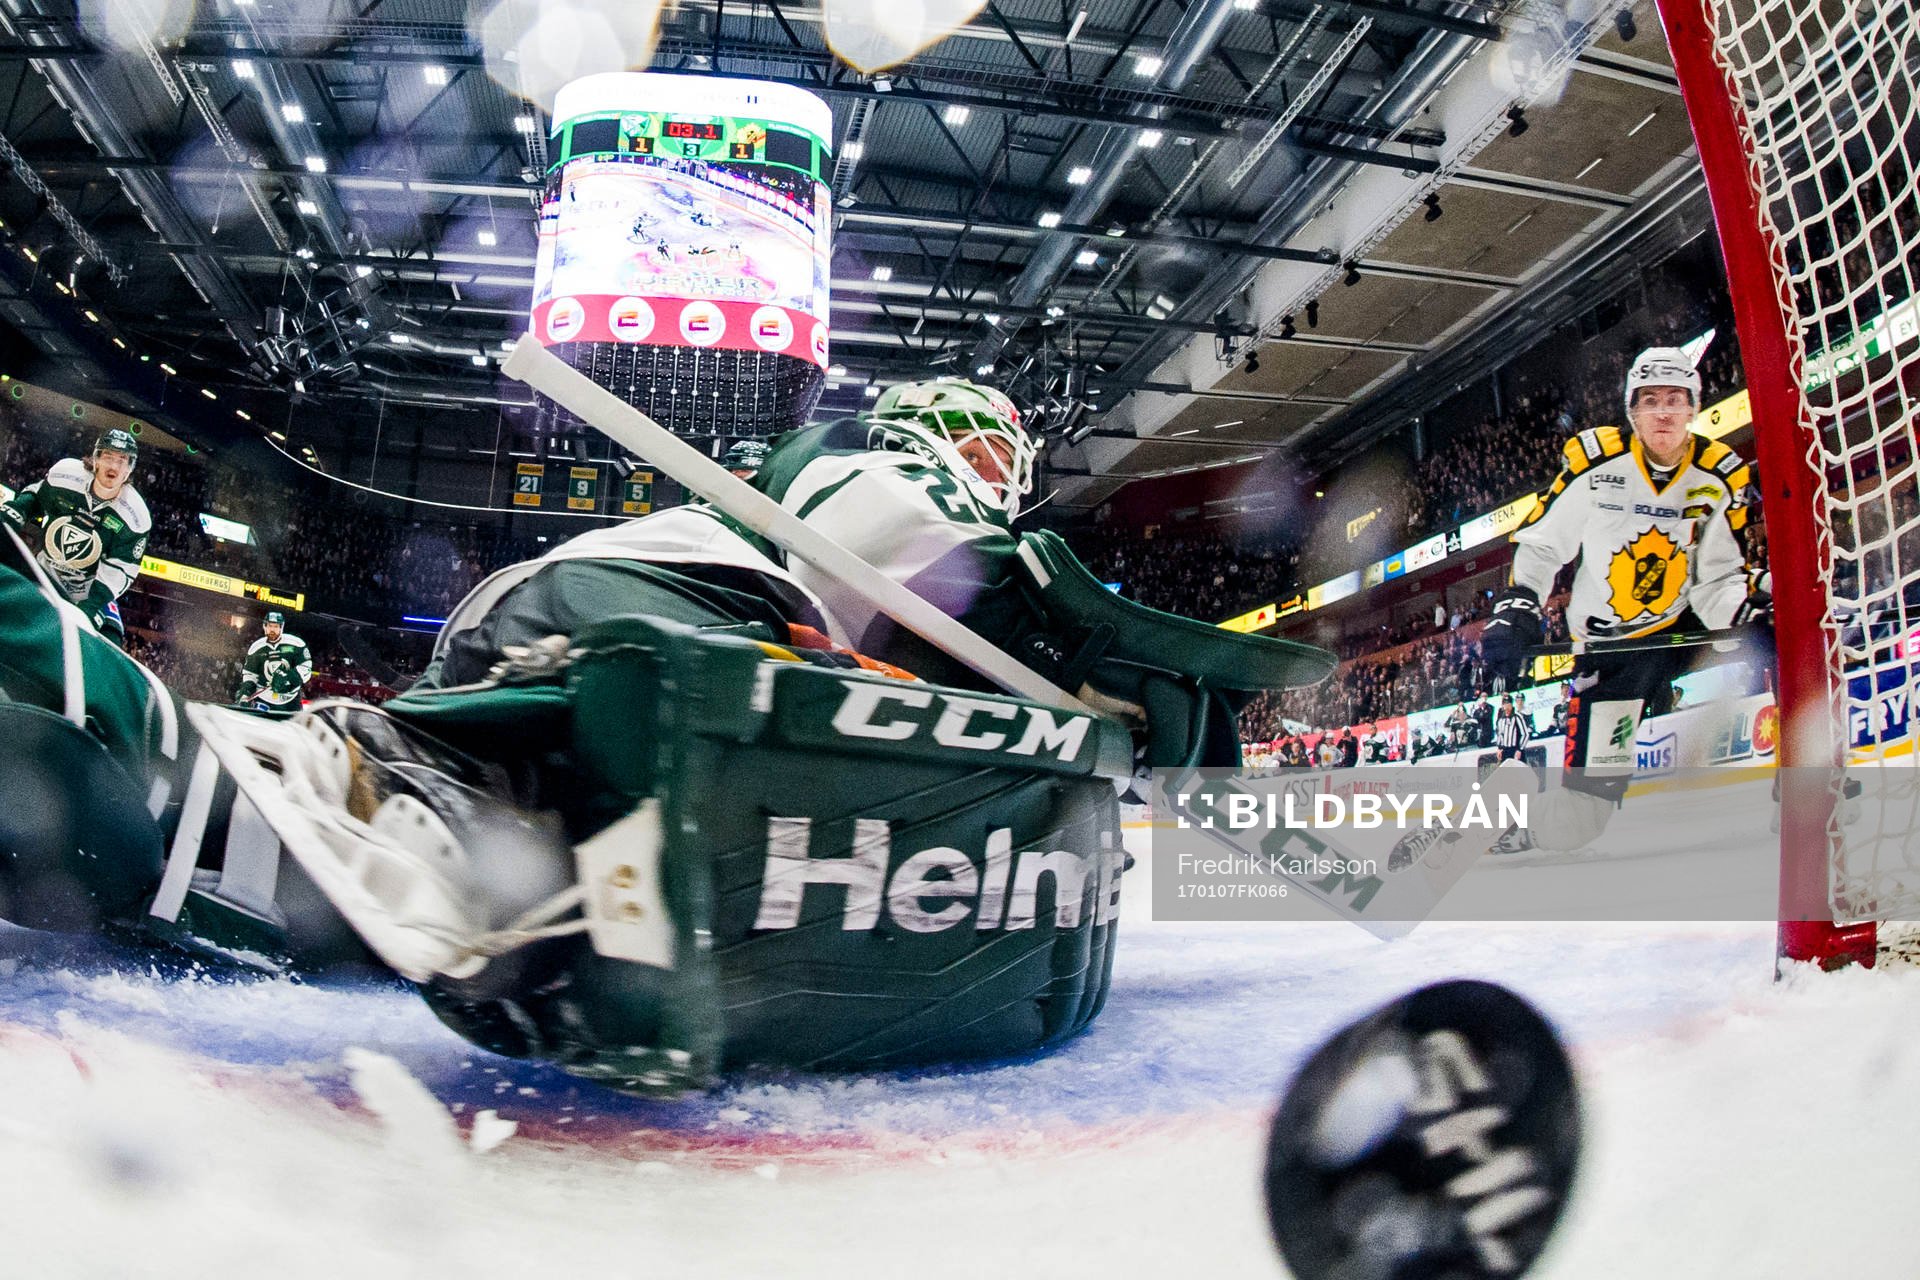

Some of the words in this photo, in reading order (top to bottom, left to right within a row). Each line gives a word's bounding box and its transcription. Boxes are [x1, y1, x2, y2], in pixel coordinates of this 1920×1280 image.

[669, 122, 717, 139] 03.1
[635, 137, 648, 152] 1
[686, 143, 697, 156] 3
[736, 144, 748, 158] 1
[519, 476, 538, 493] 21
[576, 480, 589, 497] 9
[631, 484, 644, 501] 5
[1488, 505, 1516, 527] STENA
[832, 680, 1092, 763] CCM
